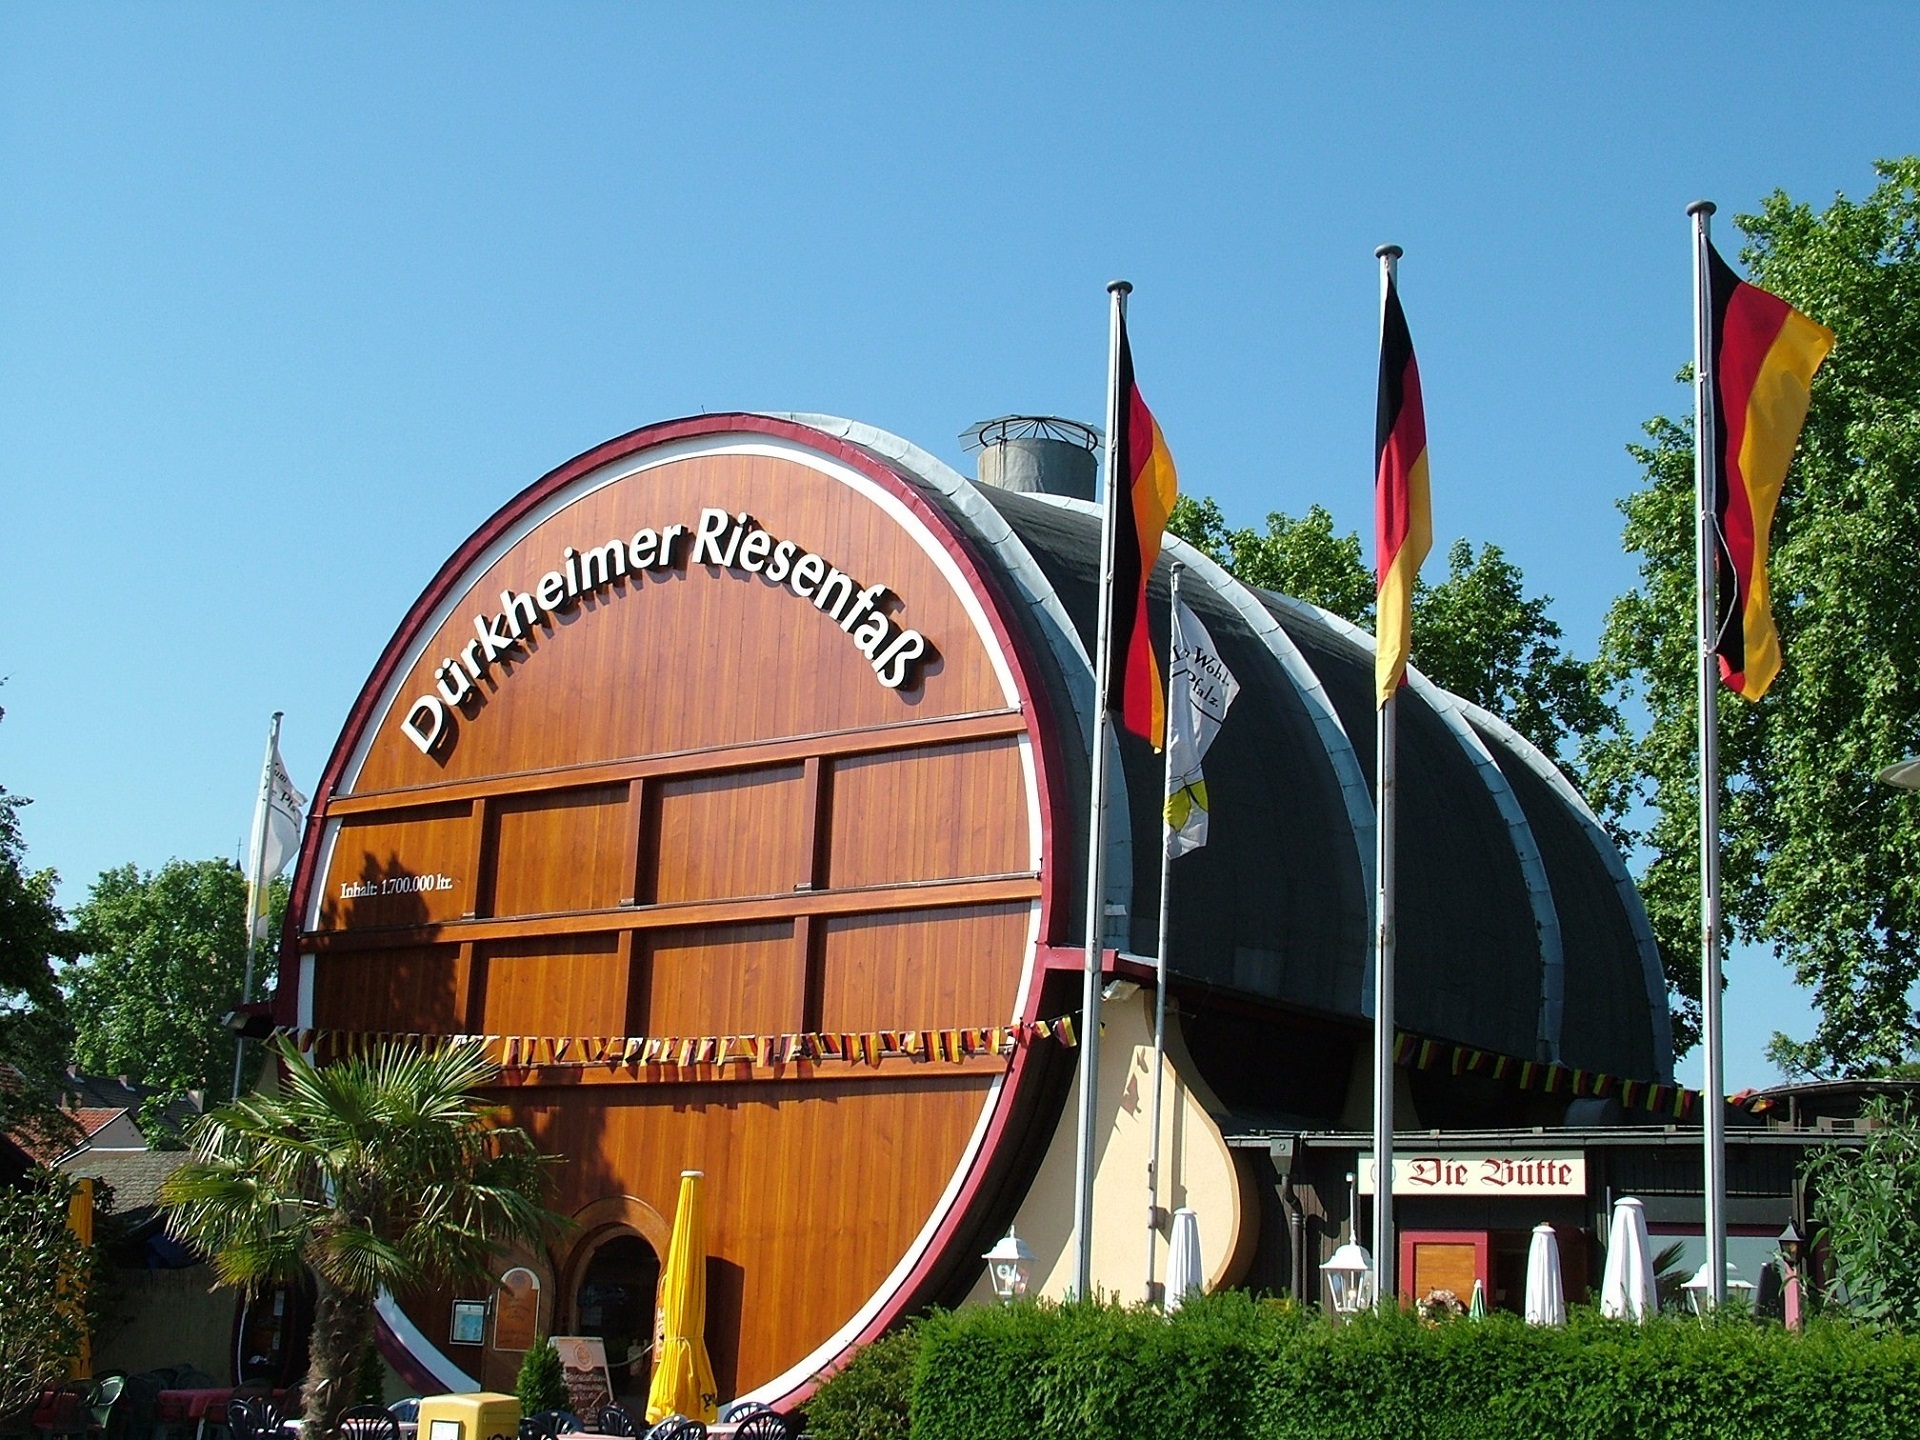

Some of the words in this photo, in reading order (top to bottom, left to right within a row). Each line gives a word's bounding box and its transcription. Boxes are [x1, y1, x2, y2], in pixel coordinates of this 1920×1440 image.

[401, 523, 682, 754] Dürkheimer
[691, 507, 925, 689] Riesenfaß
[1194, 645, 1230, 687] Wohl.
[339, 880, 378, 899] Inhalt:
[381, 874, 435, 896] 1.700.000
[1408, 1157, 1469, 1186] Die
[1480, 1156, 1573, 1187] Bütte
